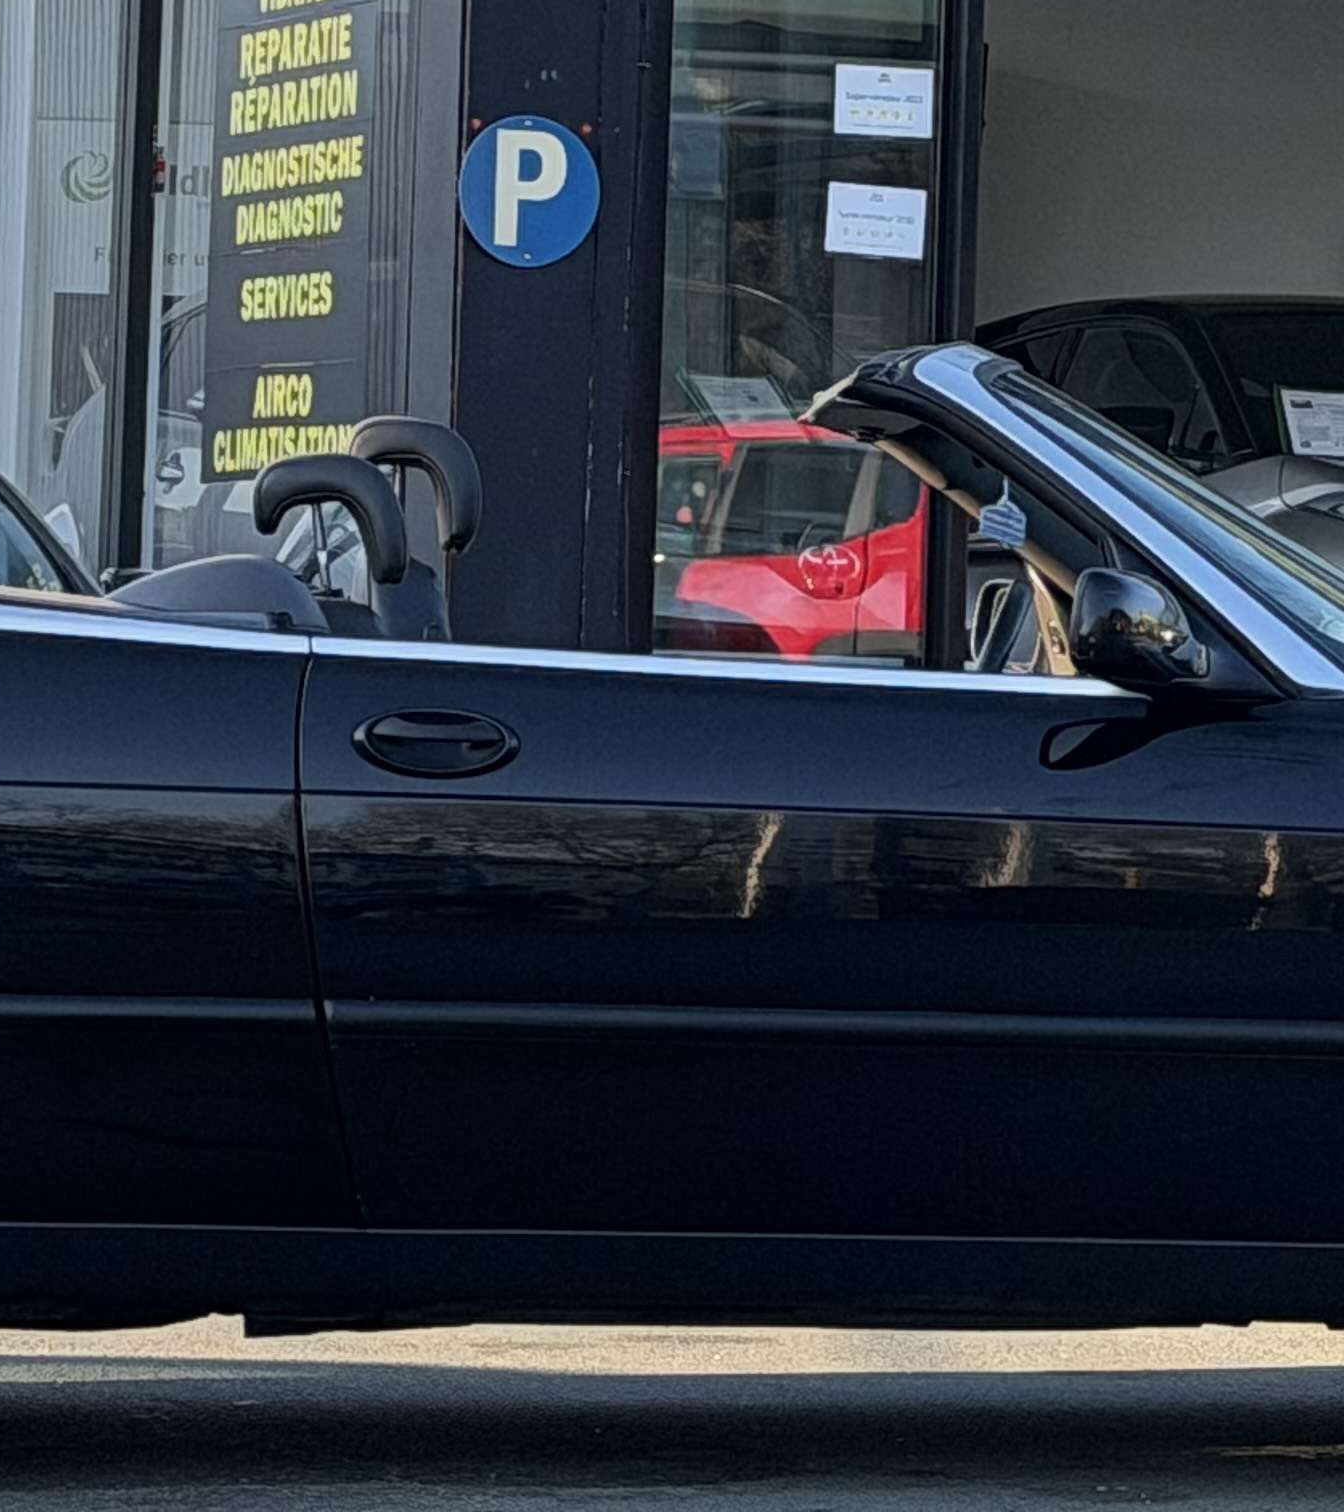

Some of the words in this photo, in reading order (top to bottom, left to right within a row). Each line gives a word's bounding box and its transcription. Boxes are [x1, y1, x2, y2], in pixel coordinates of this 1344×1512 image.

[239, 12, 353, 80] REPARATIE
[221, 134, 364, 197] DIAGNOSTISCHE
[493, 127, 569, 247] P
[235, 190, 344, 246] DIAGNOSTIC
[239, 271, 333, 322] SERVICES
[252, 373, 313, 419] AIRCO
